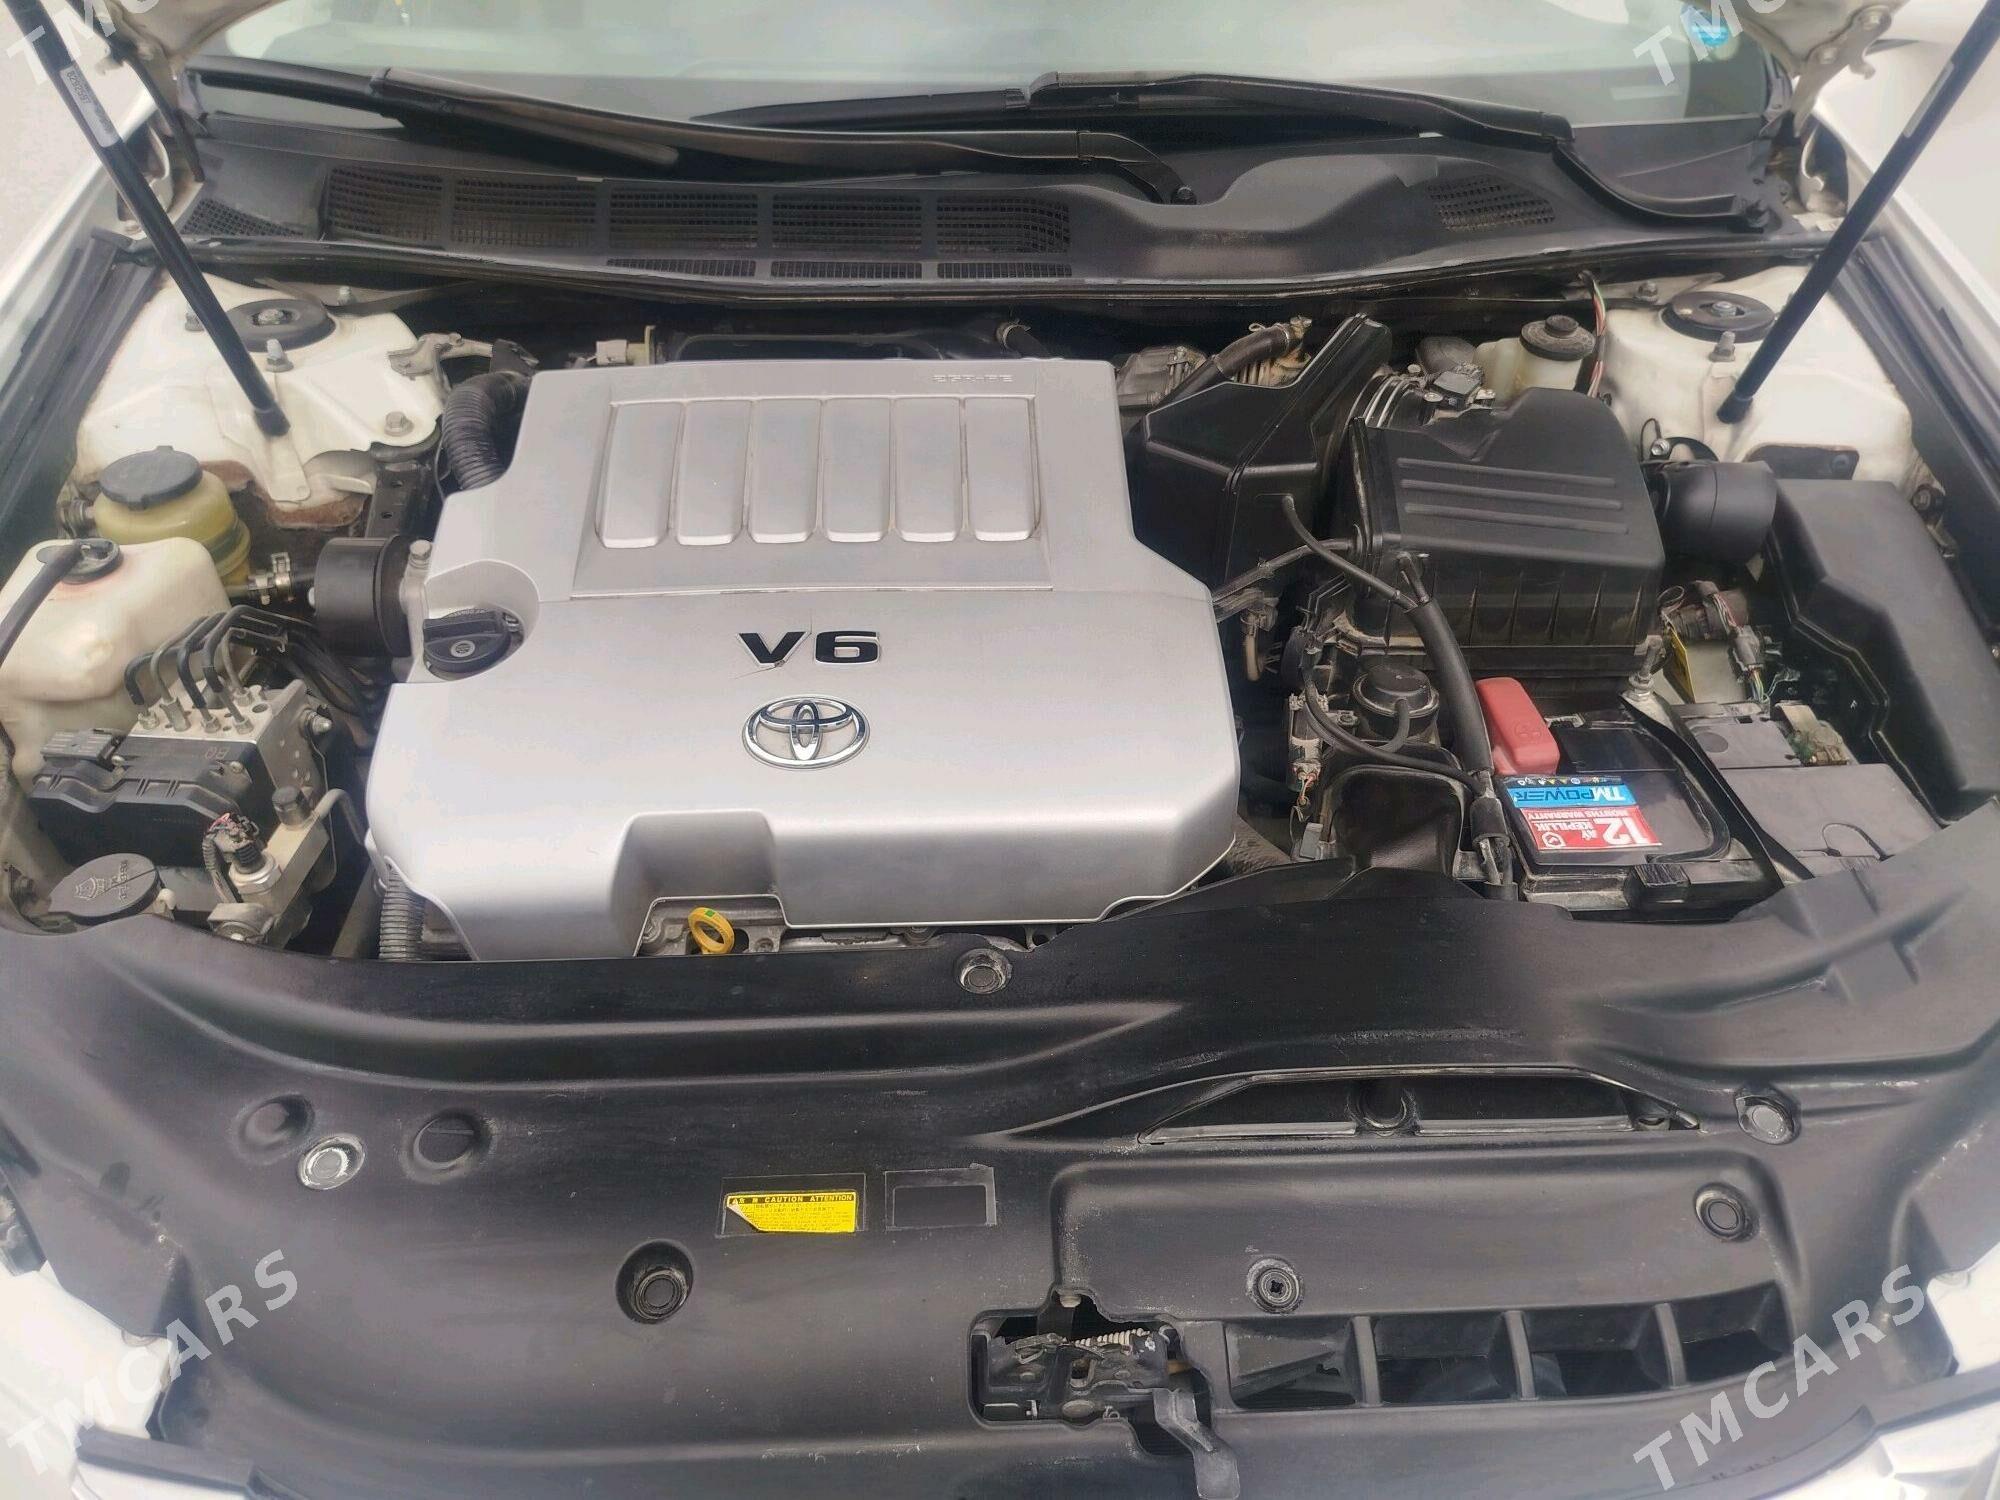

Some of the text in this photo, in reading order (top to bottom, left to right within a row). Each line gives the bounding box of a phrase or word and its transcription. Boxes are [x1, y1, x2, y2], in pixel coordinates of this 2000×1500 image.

[736, 630, 880, 667] V6
[1527, 810, 1628, 820] MONTHS WARRANTY
[1536, 821, 1593, 832] KEPILLIK
[1593, 817, 1651, 846] 12
[764, 1196, 804, 1204] CAUTION
[809, 1194, 853, 1202] ATTENTION
